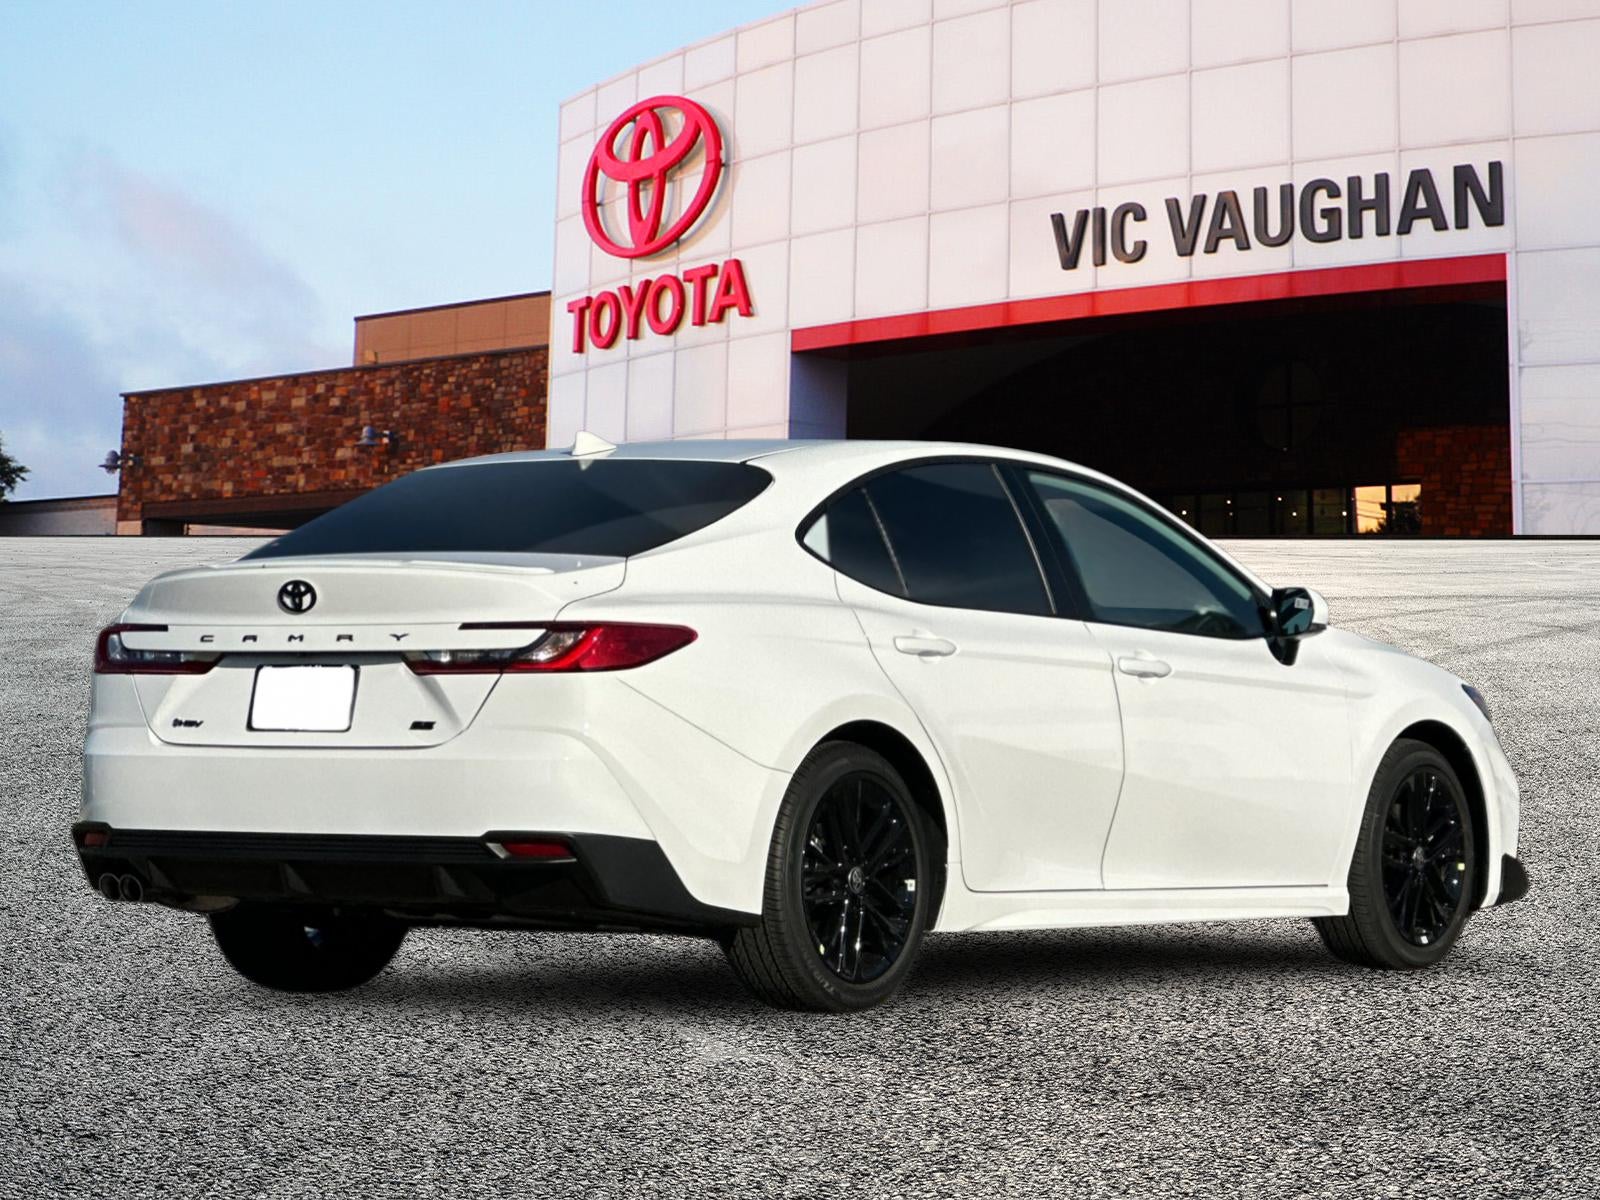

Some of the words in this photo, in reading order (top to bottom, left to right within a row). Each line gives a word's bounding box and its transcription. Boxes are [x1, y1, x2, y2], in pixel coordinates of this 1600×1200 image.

[1050, 201, 1148, 271] VIC
[1164, 160, 1506, 259] VAUGHAN
[567, 258, 754, 354] TOYOTA
[199, 633, 410, 643] CAMRY
